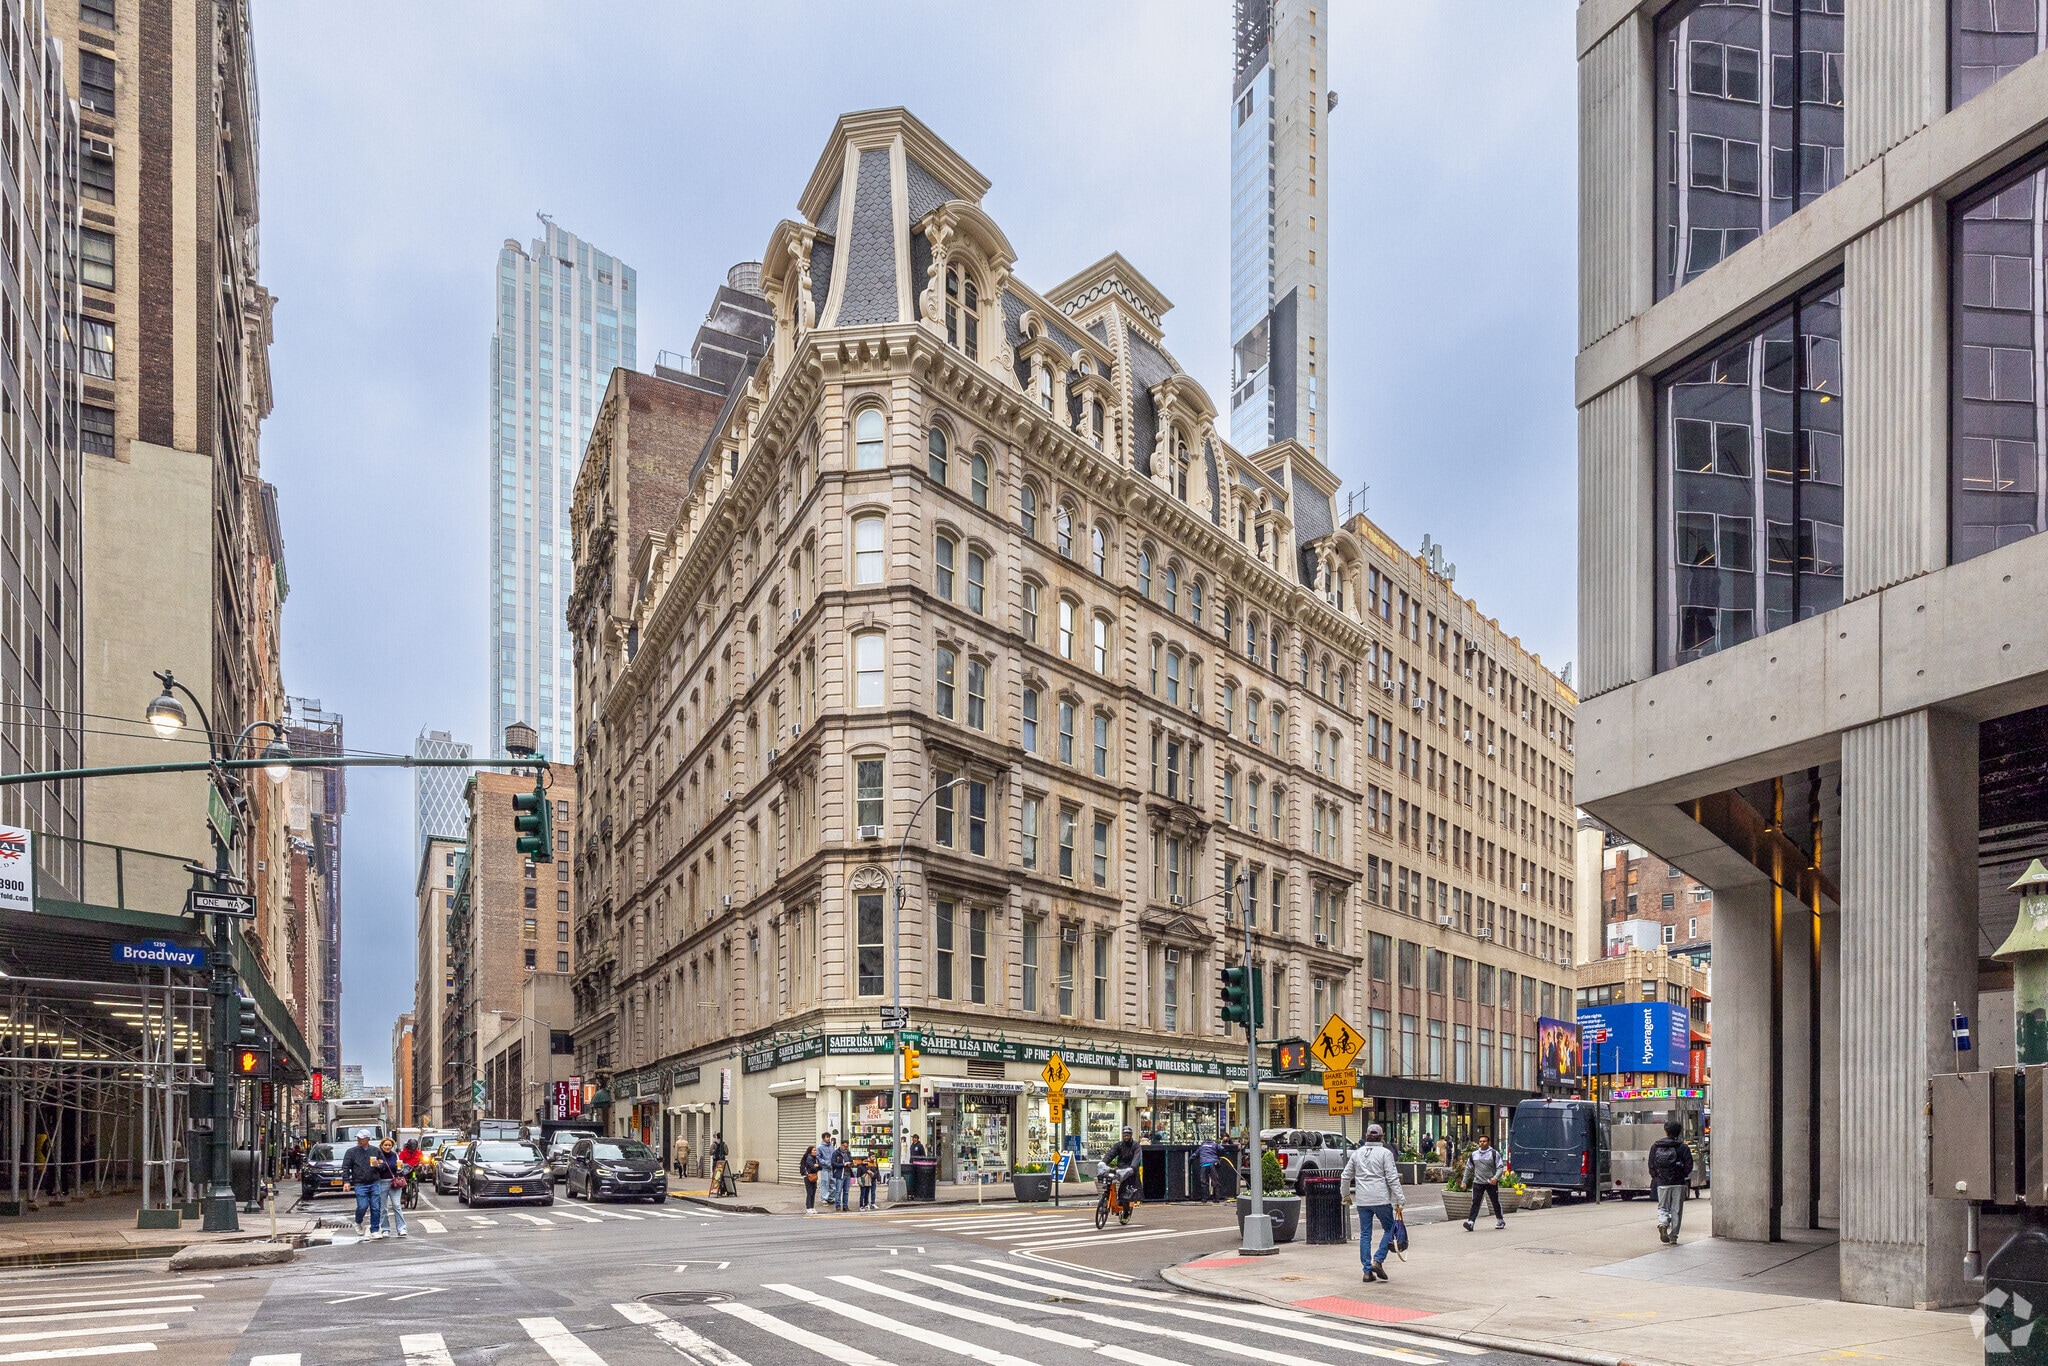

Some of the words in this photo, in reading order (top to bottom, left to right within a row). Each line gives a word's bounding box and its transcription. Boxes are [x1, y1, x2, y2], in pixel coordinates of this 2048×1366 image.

[202, 898, 219, 906] ONE
[226, 901, 245, 909] WAY
[123, 946, 195, 964] Broadway
[830, 1036, 856, 1048] SAHER
[856, 1036, 873, 1047] USA
[902, 1032, 919, 1041] Broadway
[1642, 1008, 1654, 1064] Hyperagent
[778, 1045, 794, 1058] SAHER
[794, 1041, 804, 1053] USA
[920, 1036, 958, 1049] SAHER
[959, 1039, 980, 1052] USA
[982, 1042, 1003, 1053] INC.
[927, 1047, 948, 1055] PERFUME
[1023, 1047, 1033, 1059] JP
[1034, 1048, 1050, 1061] FINE
[1075, 1053, 1104, 1065] JEWELRY
[1104, 1055, 1118, 1067] INC.
[1298, 1046, 1306, 1066] 2
[1136, 1058, 1154, 1069] S&P
[1154, 1060, 1191, 1072] WIRELESS
[1190, 1063, 1206, 1074] INC.
[966, 1094, 989, 1104] ROYAL
[991, 1096, 1008, 1105] TIME
[1336, 1090, 1345, 1104] 5
[1053, 1105, 1059, 1115] 5
